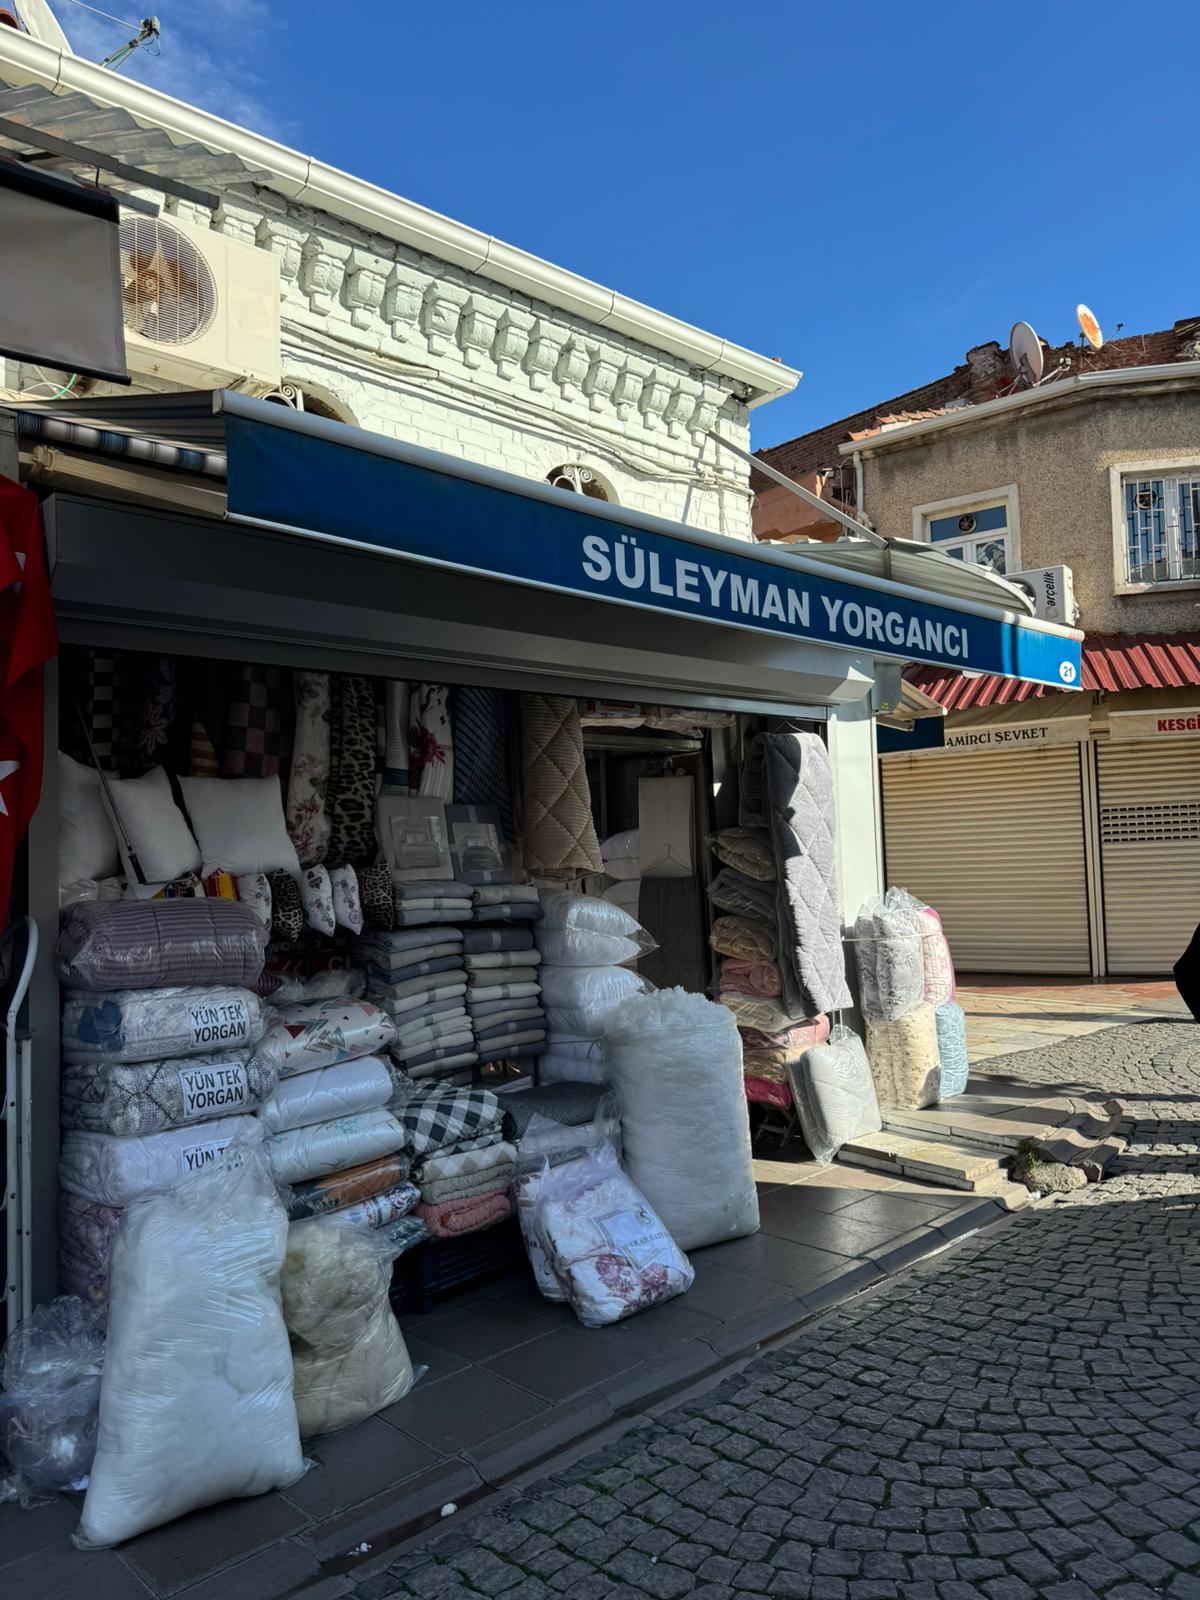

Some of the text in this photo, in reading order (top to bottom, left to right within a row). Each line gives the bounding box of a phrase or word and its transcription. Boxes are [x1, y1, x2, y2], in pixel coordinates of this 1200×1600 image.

[582, 534, 969, 659] SÜLEYMAN YORGANCI
[1043, 571, 1058, 607] arçelik
[995, 727, 1049, 744] ŞEVKET
[191, 1004, 244, 1025] YÜN TEK
[193, 1021, 246, 1043] YORGAN
[185, 1068, 241, 1092] YÜN TEK
[188, 1086, 244, 1111] YORGAN
[186, 1148, 215, 1171] YÜN
